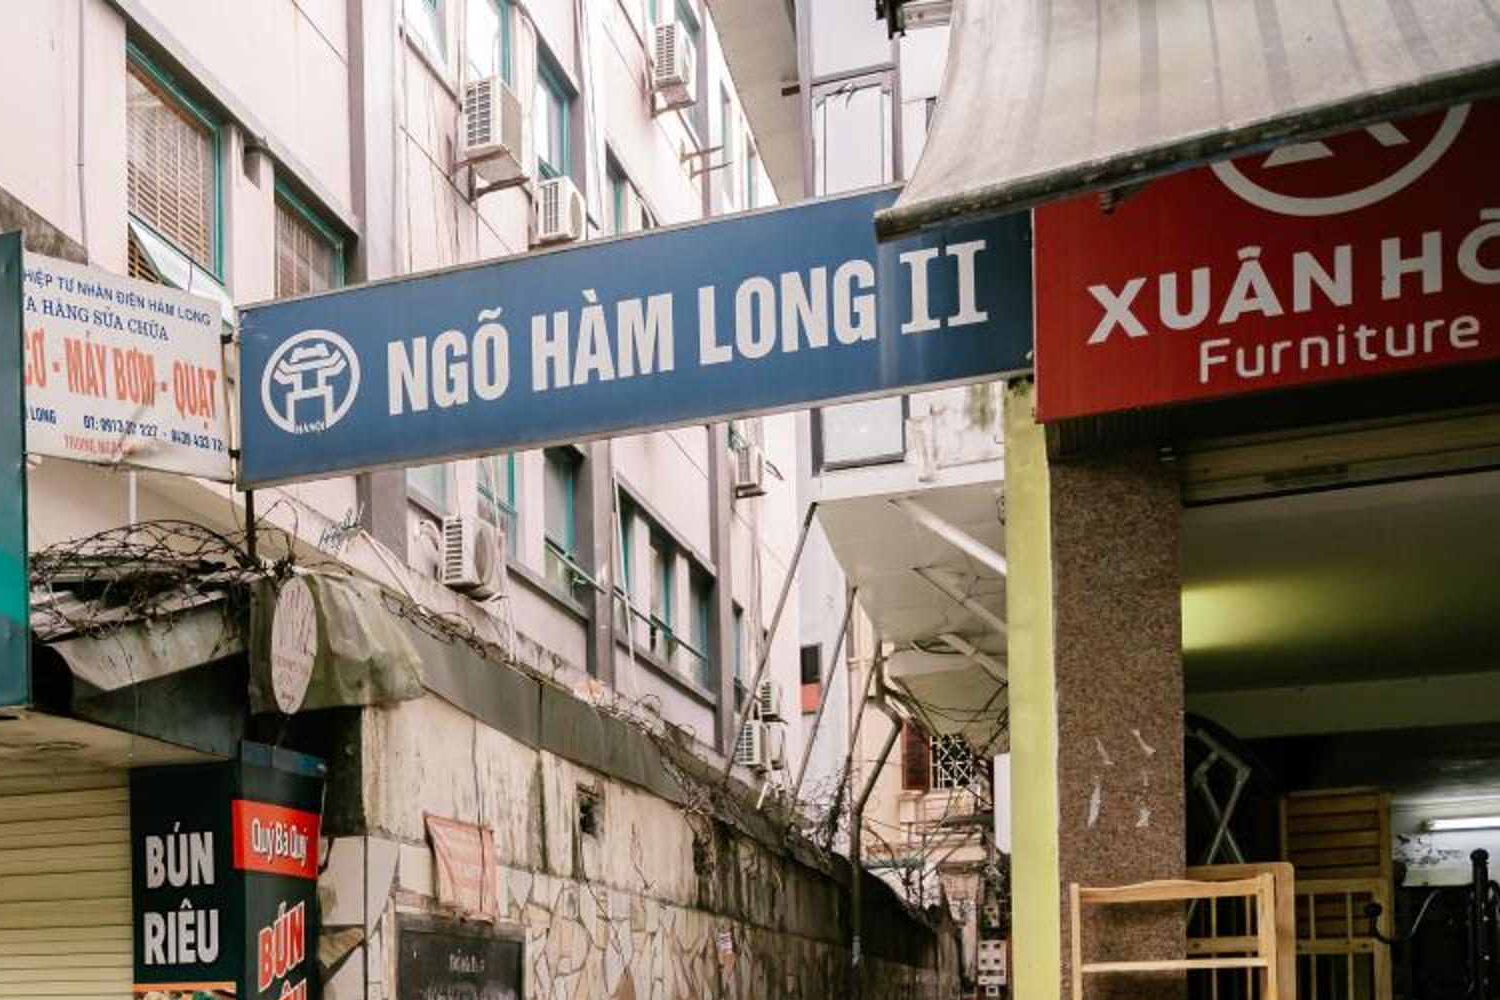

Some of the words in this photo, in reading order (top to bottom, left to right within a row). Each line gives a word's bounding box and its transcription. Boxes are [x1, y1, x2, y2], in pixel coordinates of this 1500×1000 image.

[177, 307, 211, 326] LONG
[387, 305, 510, 416] NGÕ
[531, 288, 674, 392] HÀM
[697, 259, 878, 365] LONG
[900, 240, 988, 335] II
[1087, 244, 1353, 345] XUÂN
[64, 331, 107, 398] MÁY
[113, 346, 155, 406] BƠM
[173, 359, 216, 429] QUẠT
[1200, 314, 1480, 384] Furniture
[144, 822, 215, 890] BÚN
[142, 900, 220, 966] RIÊU
[257, 899, 306, 993] BÚN
